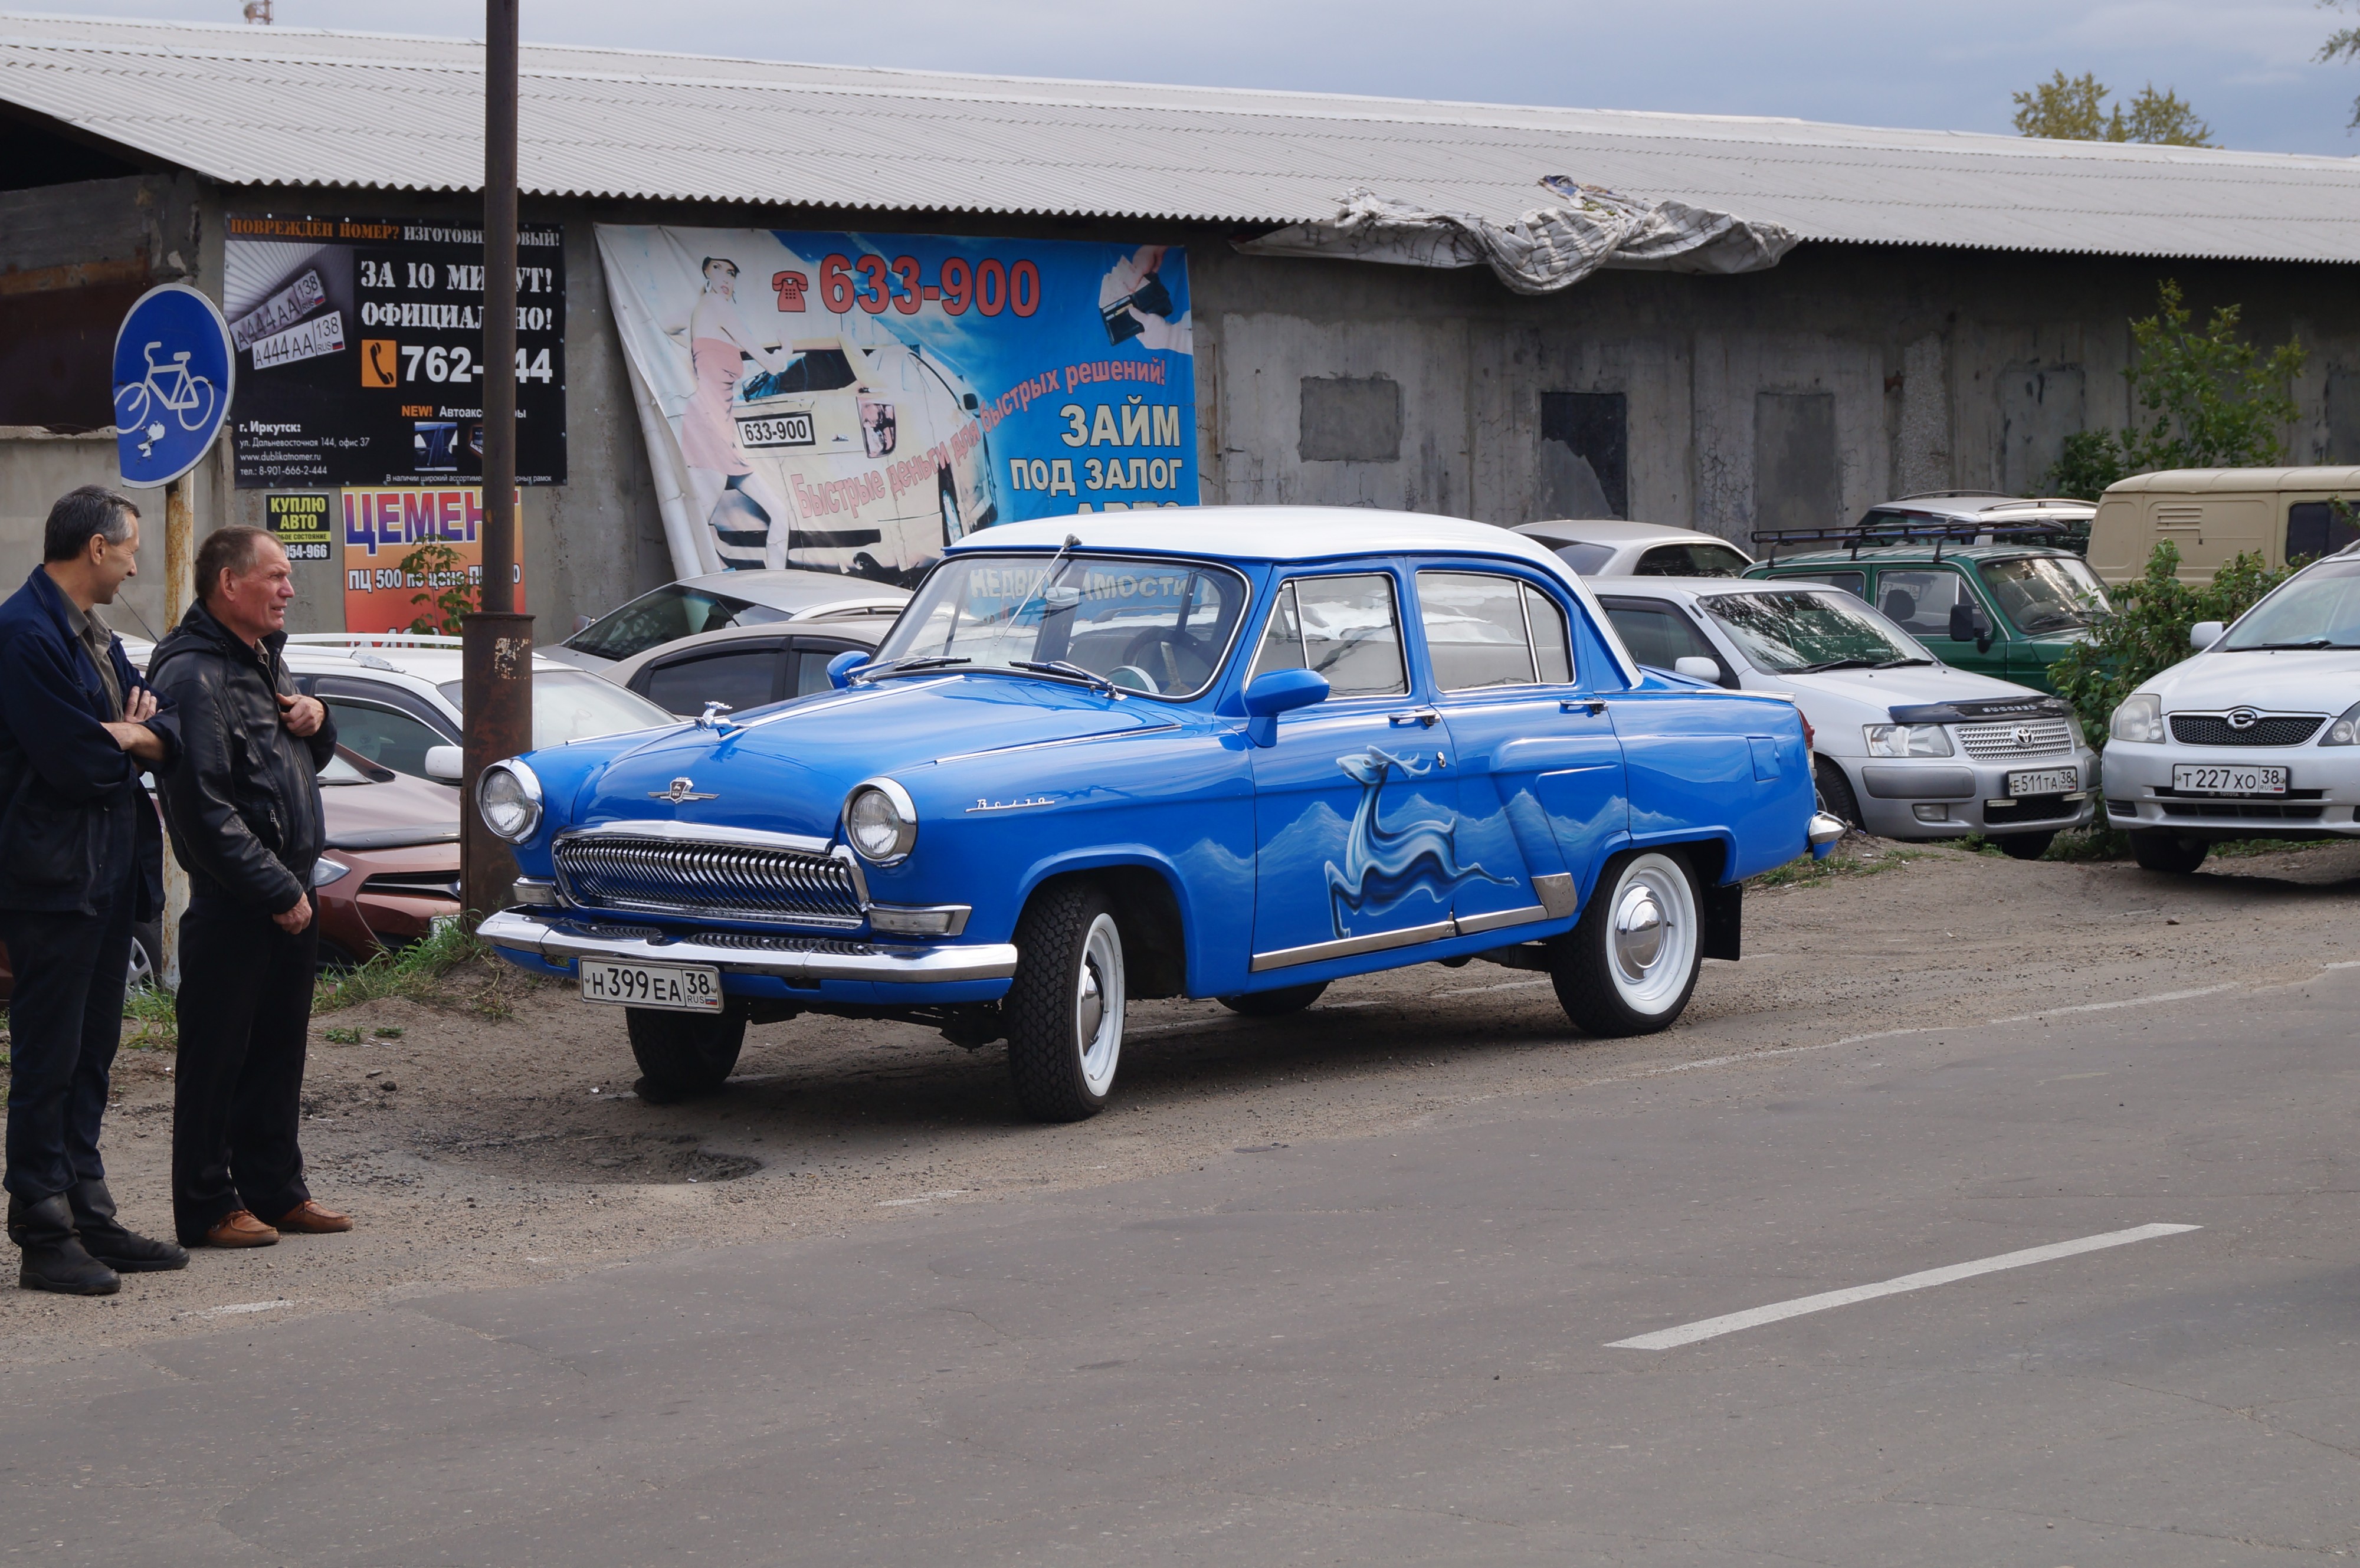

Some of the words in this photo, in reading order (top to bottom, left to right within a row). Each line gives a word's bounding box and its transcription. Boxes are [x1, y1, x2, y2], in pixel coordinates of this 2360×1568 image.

[231, 218, 333, 238] ПОВРЕЖДЁН
[339, 222, 399, 240] НОМЕР?
[404, 226, 485, 244] ИЗГОТОВИ
[297, 275, 318, 298] 138
[361, 261, 396, 288] ЗА
[407, 263, 435, 289] 10
[446, 264, 552, 293] МИУТ!
[820, 253, 1040, 317] 633-900
[302, 298, 314, 311] RUS
[361, 301, 552, 330] ОФИЦИАНО!
[316, 317, 339, 339] 138
[317, 342, 332, 353] RUS
[401, 346, 553, 383] 762-44
[401, 405, 432, 417] NEW!
[1060, 395, 1180, 447] ЗАЙМ
[240, 424, 247, 432] г.
[250, 421, 301, 435] Иркутск:
[745, 419, 807, 441] 633-900
[791, 470, 885, 519] Быстрые
[886, 441, 950, 501] деньги
[950, 419, 981, 466] для
[979, 369, 1060, 433] быстрых
[1065, 357, 1165, 393] решений!
[240, 439, 250, 449] ул.
[252, 437, 319, 448] Дальневосточная
[321, 437, 337, 448] 144,
[339, 438, 358, 449] офис
[360, 437, 370, 447] 37
[240, 451, 321, 461] www.dublikatnomer.ru
[240, 467, 257, 475] тел.:
[259, 466, 327, 475] 8-901-666-2-444
[420, 474, 448, 483] широкий
[1009, 458, 1077, 497] ПОД
[1084, 458, 1182, 490] ЗАЛОГ
[271, 497, 326, 513] КУПЛЮ
[280, 514, 317, 529] АВТО
[342, 490, 519, 556] ЦЕМЕН
[348, 569, 372, 593] ПЦ
[375, 568, 402, 589] 500
[2014, 774, 2057, 792] Е511ТА
[2061, 771, 2071, 783] 38
[2183, 769, 2256, 789] Т227ХО
[2261, 770, 2279, 784] 38
[592, 967, 682, 1002] Н399ЕА
[686, 973, 710, 995] 38
[687, 995, 704, 1003] RUS
